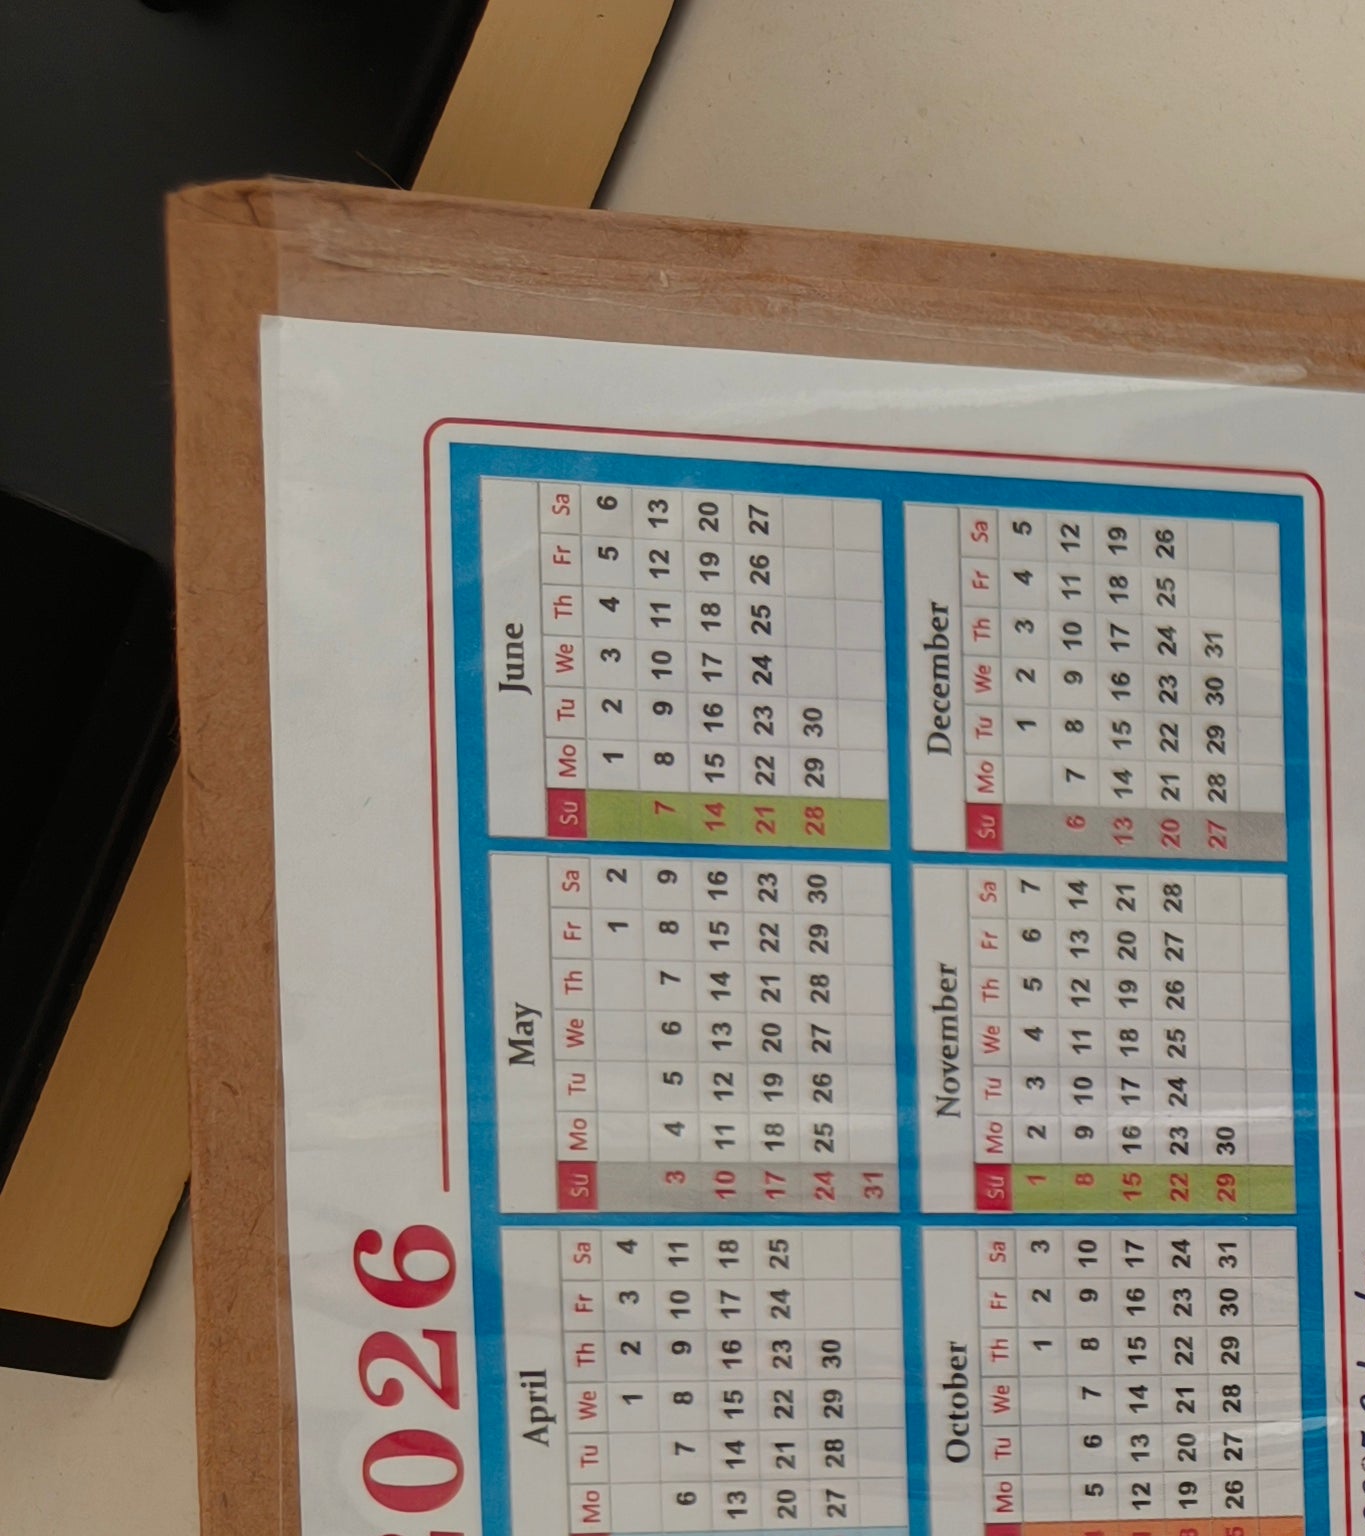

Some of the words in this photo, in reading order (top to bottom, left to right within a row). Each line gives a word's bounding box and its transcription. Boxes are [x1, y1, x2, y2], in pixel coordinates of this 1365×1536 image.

[697, 501, 719, 533] 20
[970, 520, 989, 543] Sa
[1059, 523, 1081, 553] 12
[698, 551, 720, 582] 19
[971, 570, 990, 590] Fr
[1060, 575, 1082, 600] 11
[700, 602, 722, 632] 18
[972, 618, 991, 642] Th
[1062, 621, 1083, 651] 10
[498, 622, 533, 696] June
[701, 652, 723, 683] 17
[922, 601, 952, 755] December
[974, 664, 992, 693] We
[1063, 670, 1084, 685] 9
[702, 703, 724, 733] 16
[974, 716, 993, 740] Tu
[1064, 719, 1085, 734] 8
[704, 753, 725, 783] 15
[976, 760, 995, 794] Mo
[1065, 767, 1086, 783] 7
[704, 802, 726, 832] 14
[976, 814, 996, 839] Su
[1064, 814, 1086, 830] 6
[561, 870, 581, 893] Sa
[806, 873, 828, 904] 30
[1019, 878, 1041, 894] 7
[562, 921, 582, 941] Fr
[807, 923, 829, 954] 29
[1021, 928, 1042, 943] 6
[563, 970, 583, 995] Th
[809, 974, 830, 1004] 28
[1022, 977, 1043, 992] 5
[507, 1001, 543, 1066] May
[565, 1018, 585, 1049] We
[810, 1023, 832, 1054] 27
[931, 962, 961, 1118] November
[1023, 1026, 1044, 1042] 4
[567, 1072, 587, 1097] Tu
[812, 1073, 833, 1104] 26
[1025, 1075, 1046, 1091] 3
[568, 1118, 588, 1151] Mo
[813, 1122, 835, 1153] 25
[1026, 1125, 1047, 1140] 2
[569, 1173, 589, 1198] Su
[813, 1170, 835, 1201] 24
[1025, 1174, 1047, 1186] 1
[615, 1239, 638, 1255] 4
[667, 1242, 689, 1267] 11
[988, 1240, 1007, 1263] Sa
[1171, 1239, 1191, 1269] 24
[618, 1290, 640, 1305] 3
[669, 1289, 691, 1319] 10
[989, 1291, 1008, 1310] Fr
[1172, 1287, 1193, 1317] 23
[620, 1340, 642, 1356] 2
[671, 1340, 692, 1355] 9
[989, 1338, 1009, 1363] Th
[1174, 1336, 1194, 1366] 22
[518, 1370, 556, 1447] April
[621, 1394, 644, 1406] 1
[672, 1390, 694, 1405] 8
[941, 1344, 970, 1464] October
[992, 1384, 1011, 1414] We
[1174, 1387, 1195, 1414] 21
[673, 1441, 696, 1456] 7
[993, 1437, 1012, 1461] Tu
[1176, 1432, 1197, 1462] 20
[675, 1491, 697, 1506] 6
[995, 1481, 1014, 1513] Mo
[1178, 1481, 1198, 1510] 19
